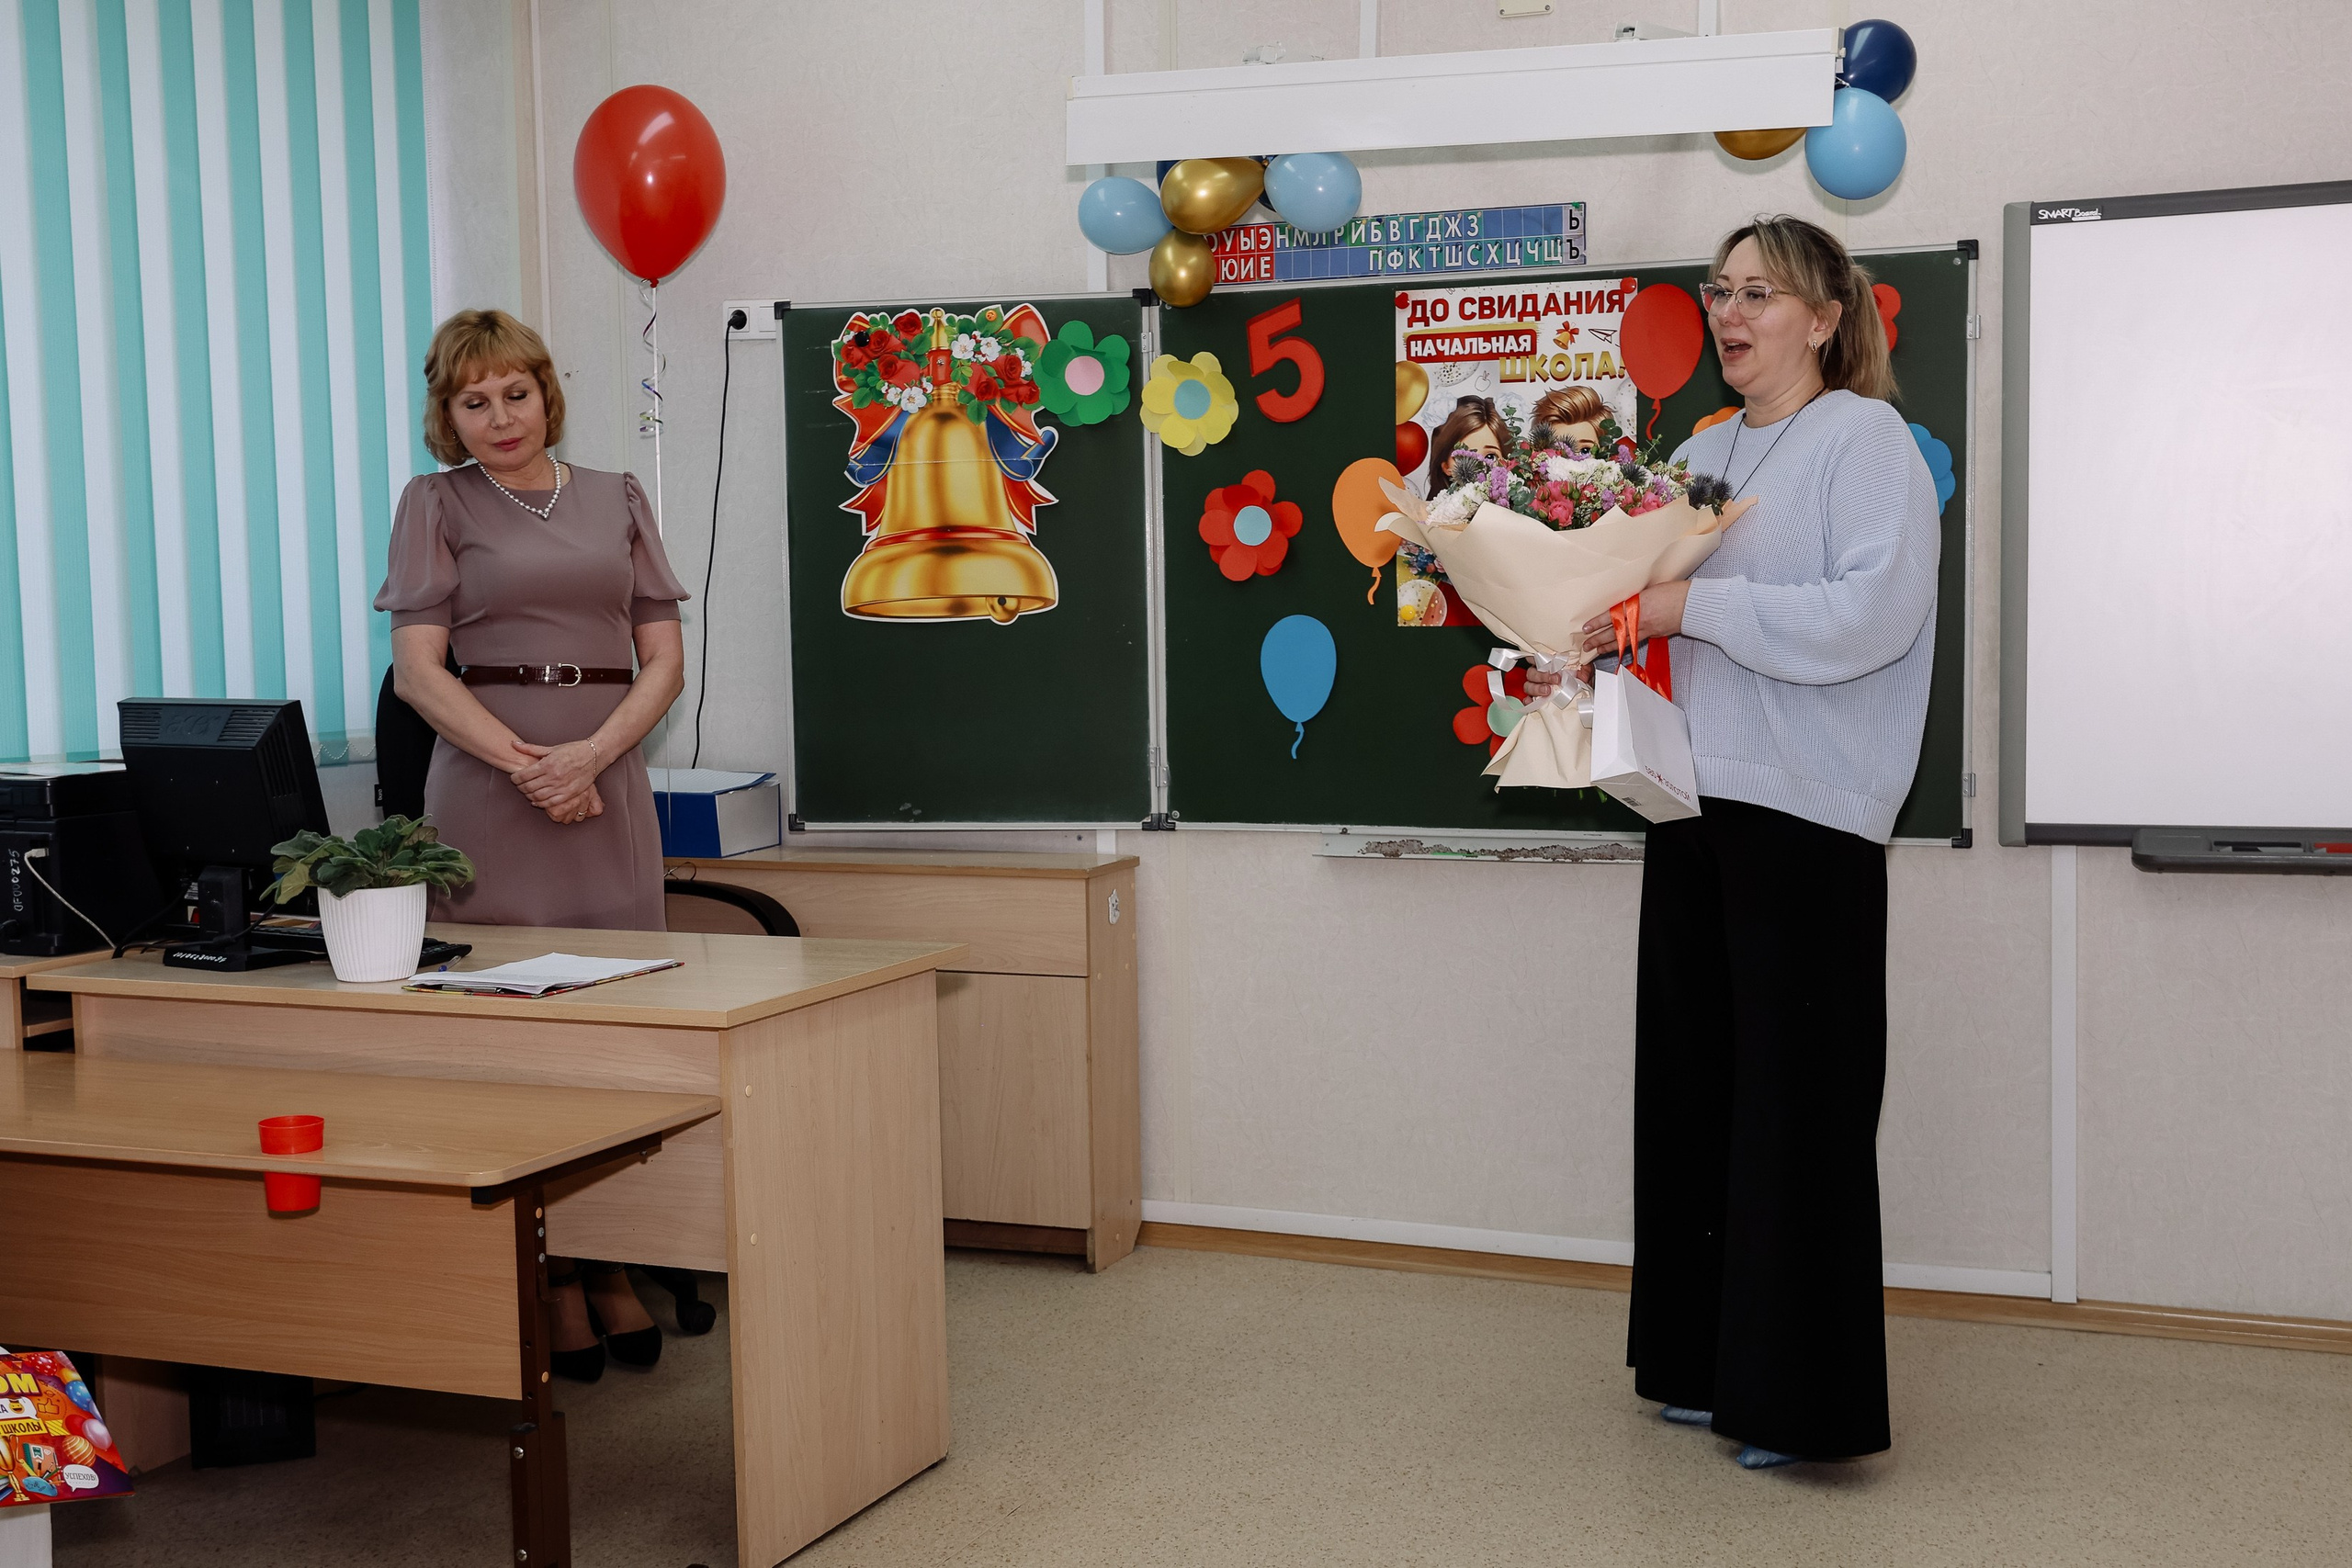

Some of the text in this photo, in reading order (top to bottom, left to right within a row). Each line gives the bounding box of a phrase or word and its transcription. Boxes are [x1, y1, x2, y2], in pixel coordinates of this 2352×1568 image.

[1221, 231, 1235, 252] У
[1240, 229, 1255, 251] Ы
[1259, 228, 1272, 249] Э
[1276, 227, 1290, 248] Н
[1351, 220, 1366, 243] Й
[1370, 221, 1382, 243] Б
[1389, 220, 1400, 242] В
[1408, 219, 1419, 240] Г
[1426, 218, 1442, 242] Д
[1445, 216, 1463, 238] Ж
[1467, 214, 1479, 237] З
[1568, 209, 1579, 231] Ь
[2038, 208, 2075, 220] SMART
[1221, 238, 1579, 281] Ю И Е П Ф К Т Ш С Х Ц Ч Щ Ъ
[1407, 289, 1625, 328] ДО СВИДАНИЯ
[1246, 296, 1325, 423] 5
[1409, 333, 1532, 357] НАЧАЛЬНАЯ
[1, 1421, 43, 1434] ШКОЛЫ
